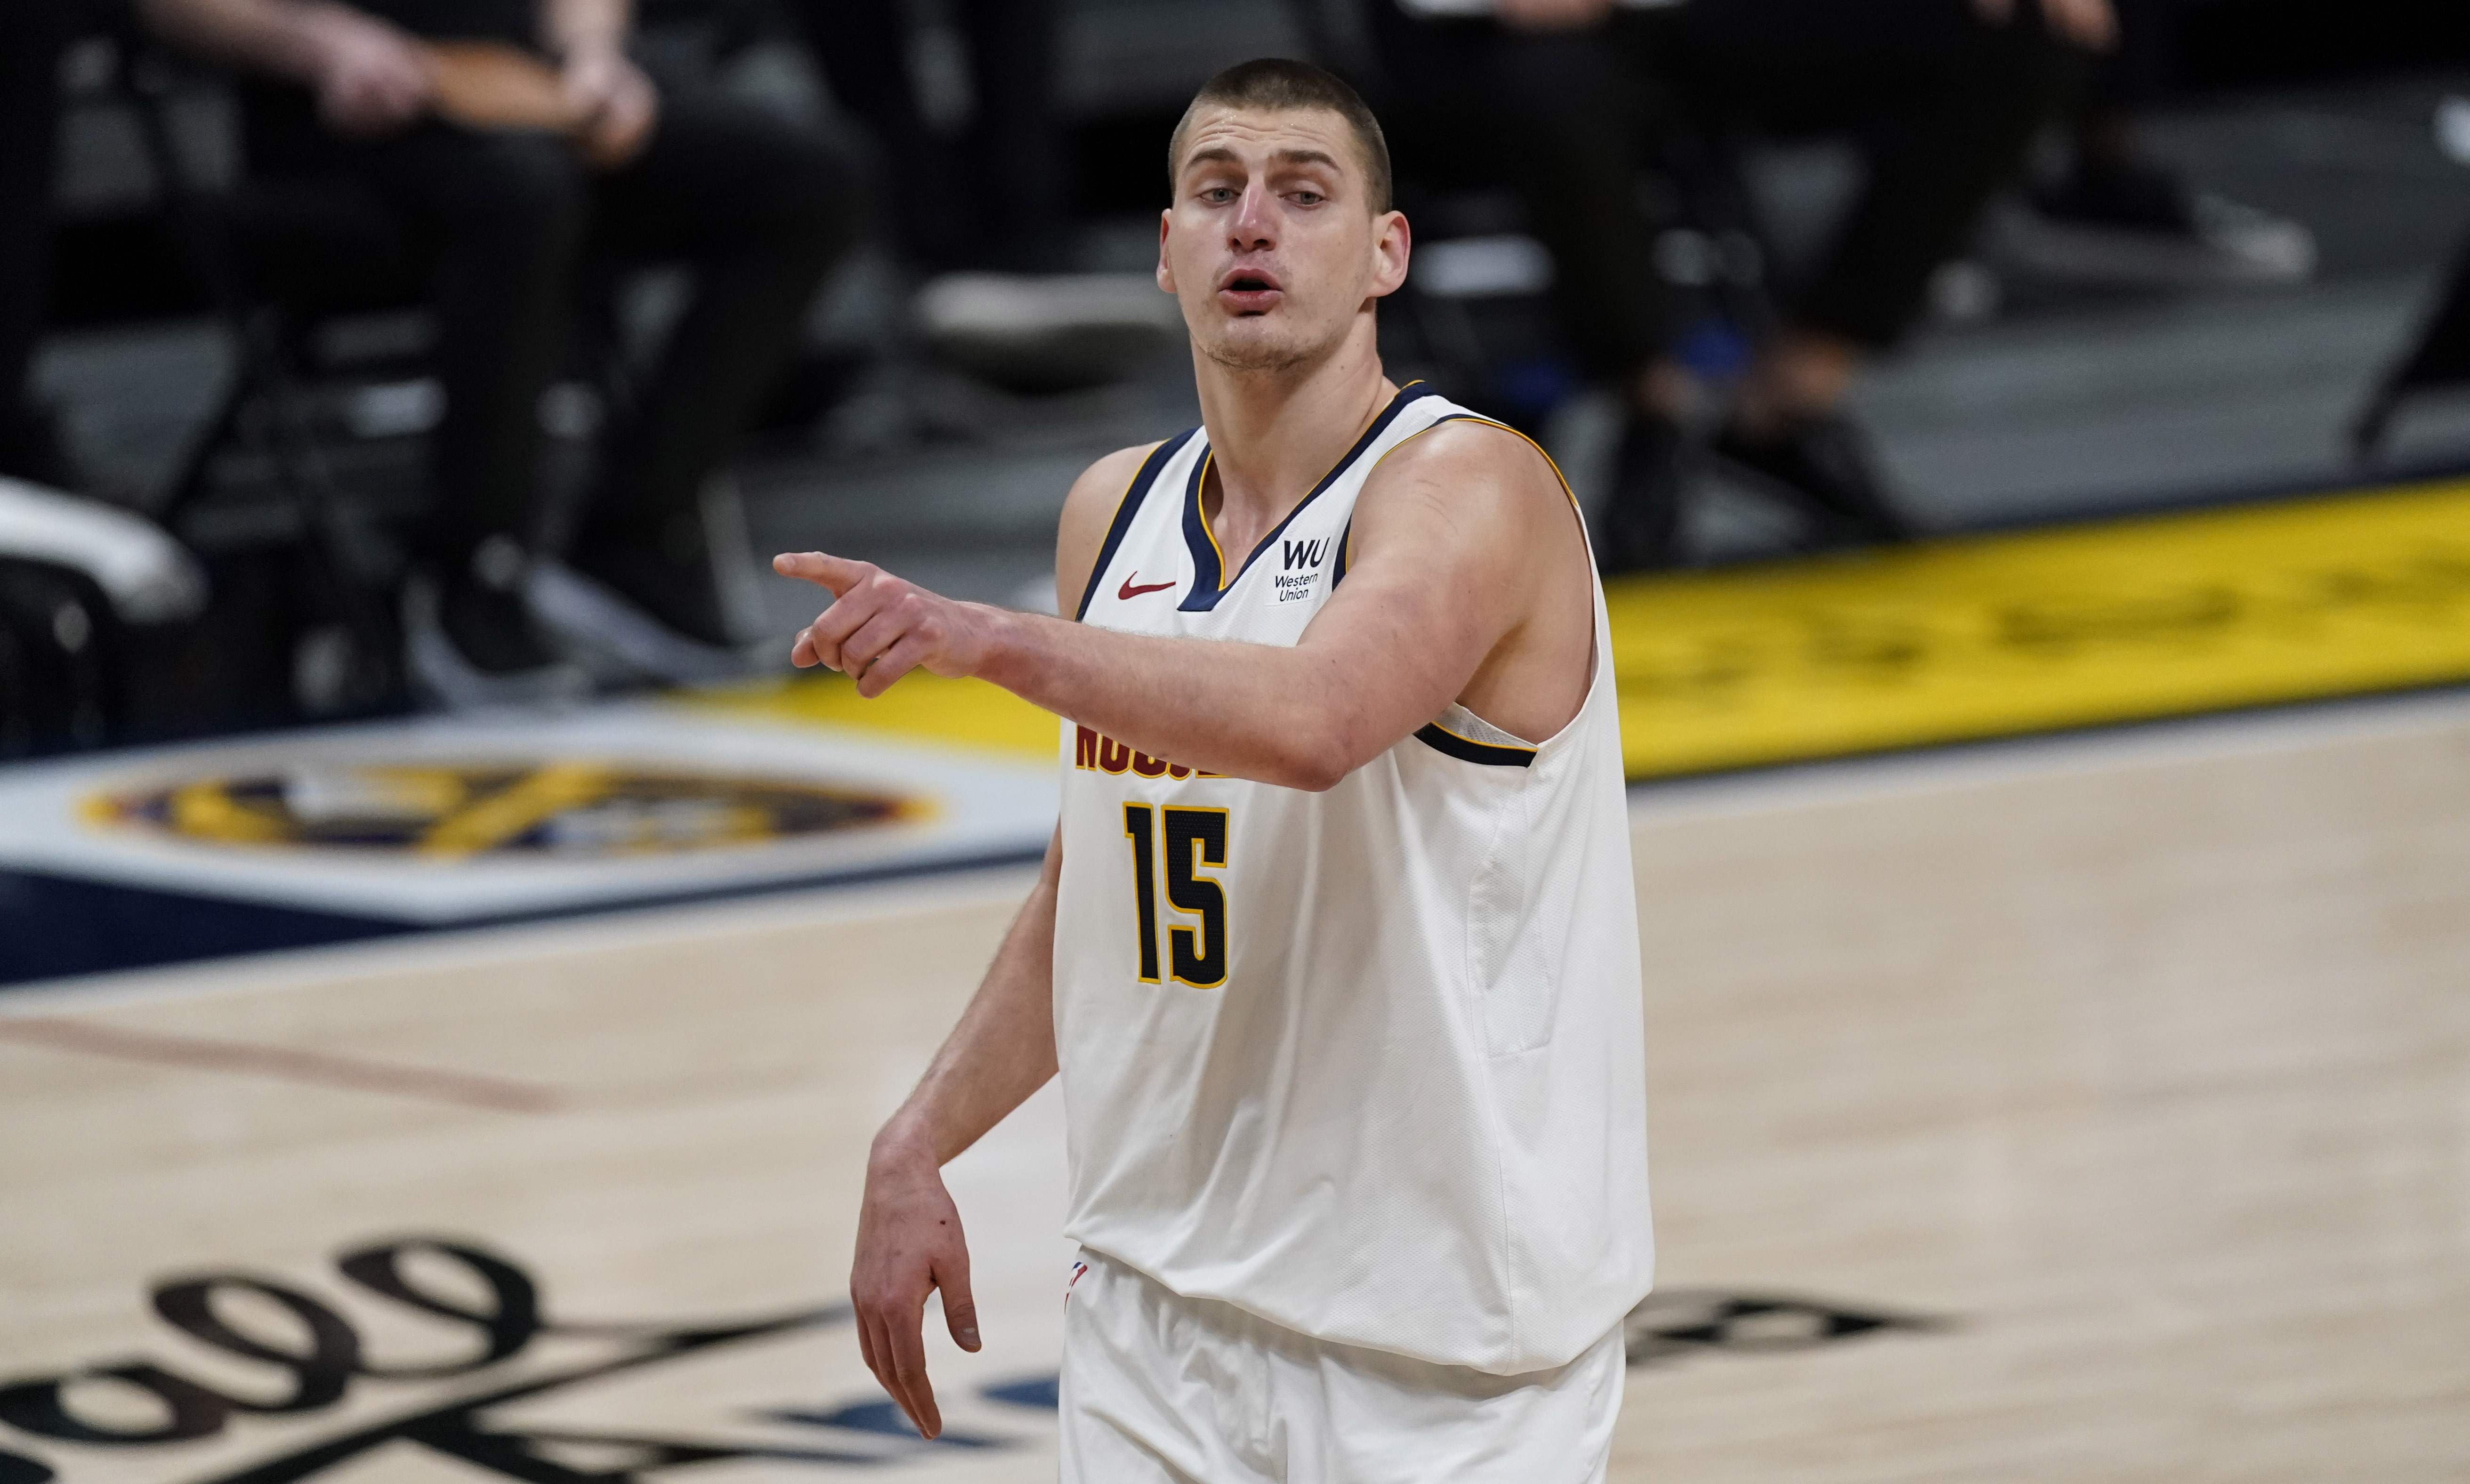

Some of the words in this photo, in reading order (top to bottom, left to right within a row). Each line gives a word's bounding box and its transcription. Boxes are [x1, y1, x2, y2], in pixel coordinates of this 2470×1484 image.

[1284, 537, 1330, 570] WU
[1275, 573, 1318, 588] Western
[1279, 588, 1308, 602] Union
[1122, 801, 1229, 989] 15
